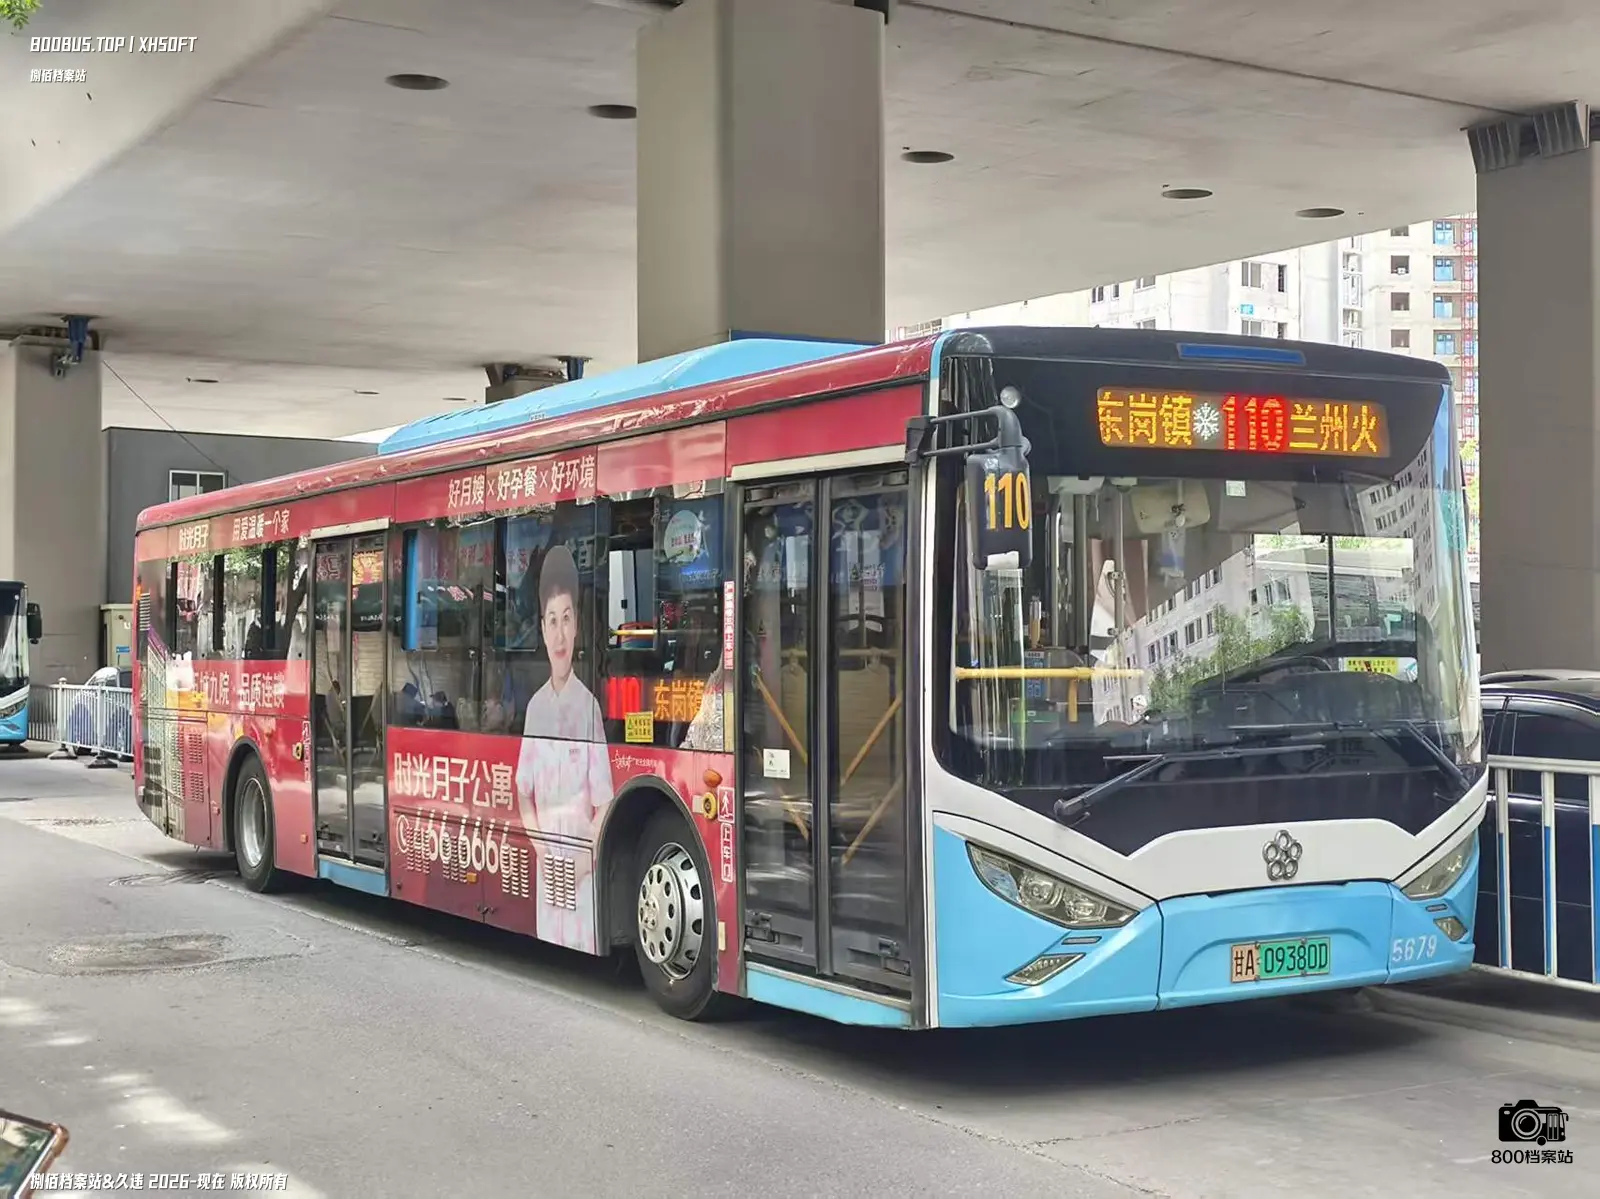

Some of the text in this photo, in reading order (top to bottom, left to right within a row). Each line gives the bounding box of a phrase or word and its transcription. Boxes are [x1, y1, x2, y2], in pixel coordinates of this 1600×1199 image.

[1097, 391, 1378, 453] 东岗镇 110 兰州火
[984, 472, 1030, 529] 110
[394, 752, 513, 811] 时光月子公寓
[1391, 935, 1438, 963] 5679
